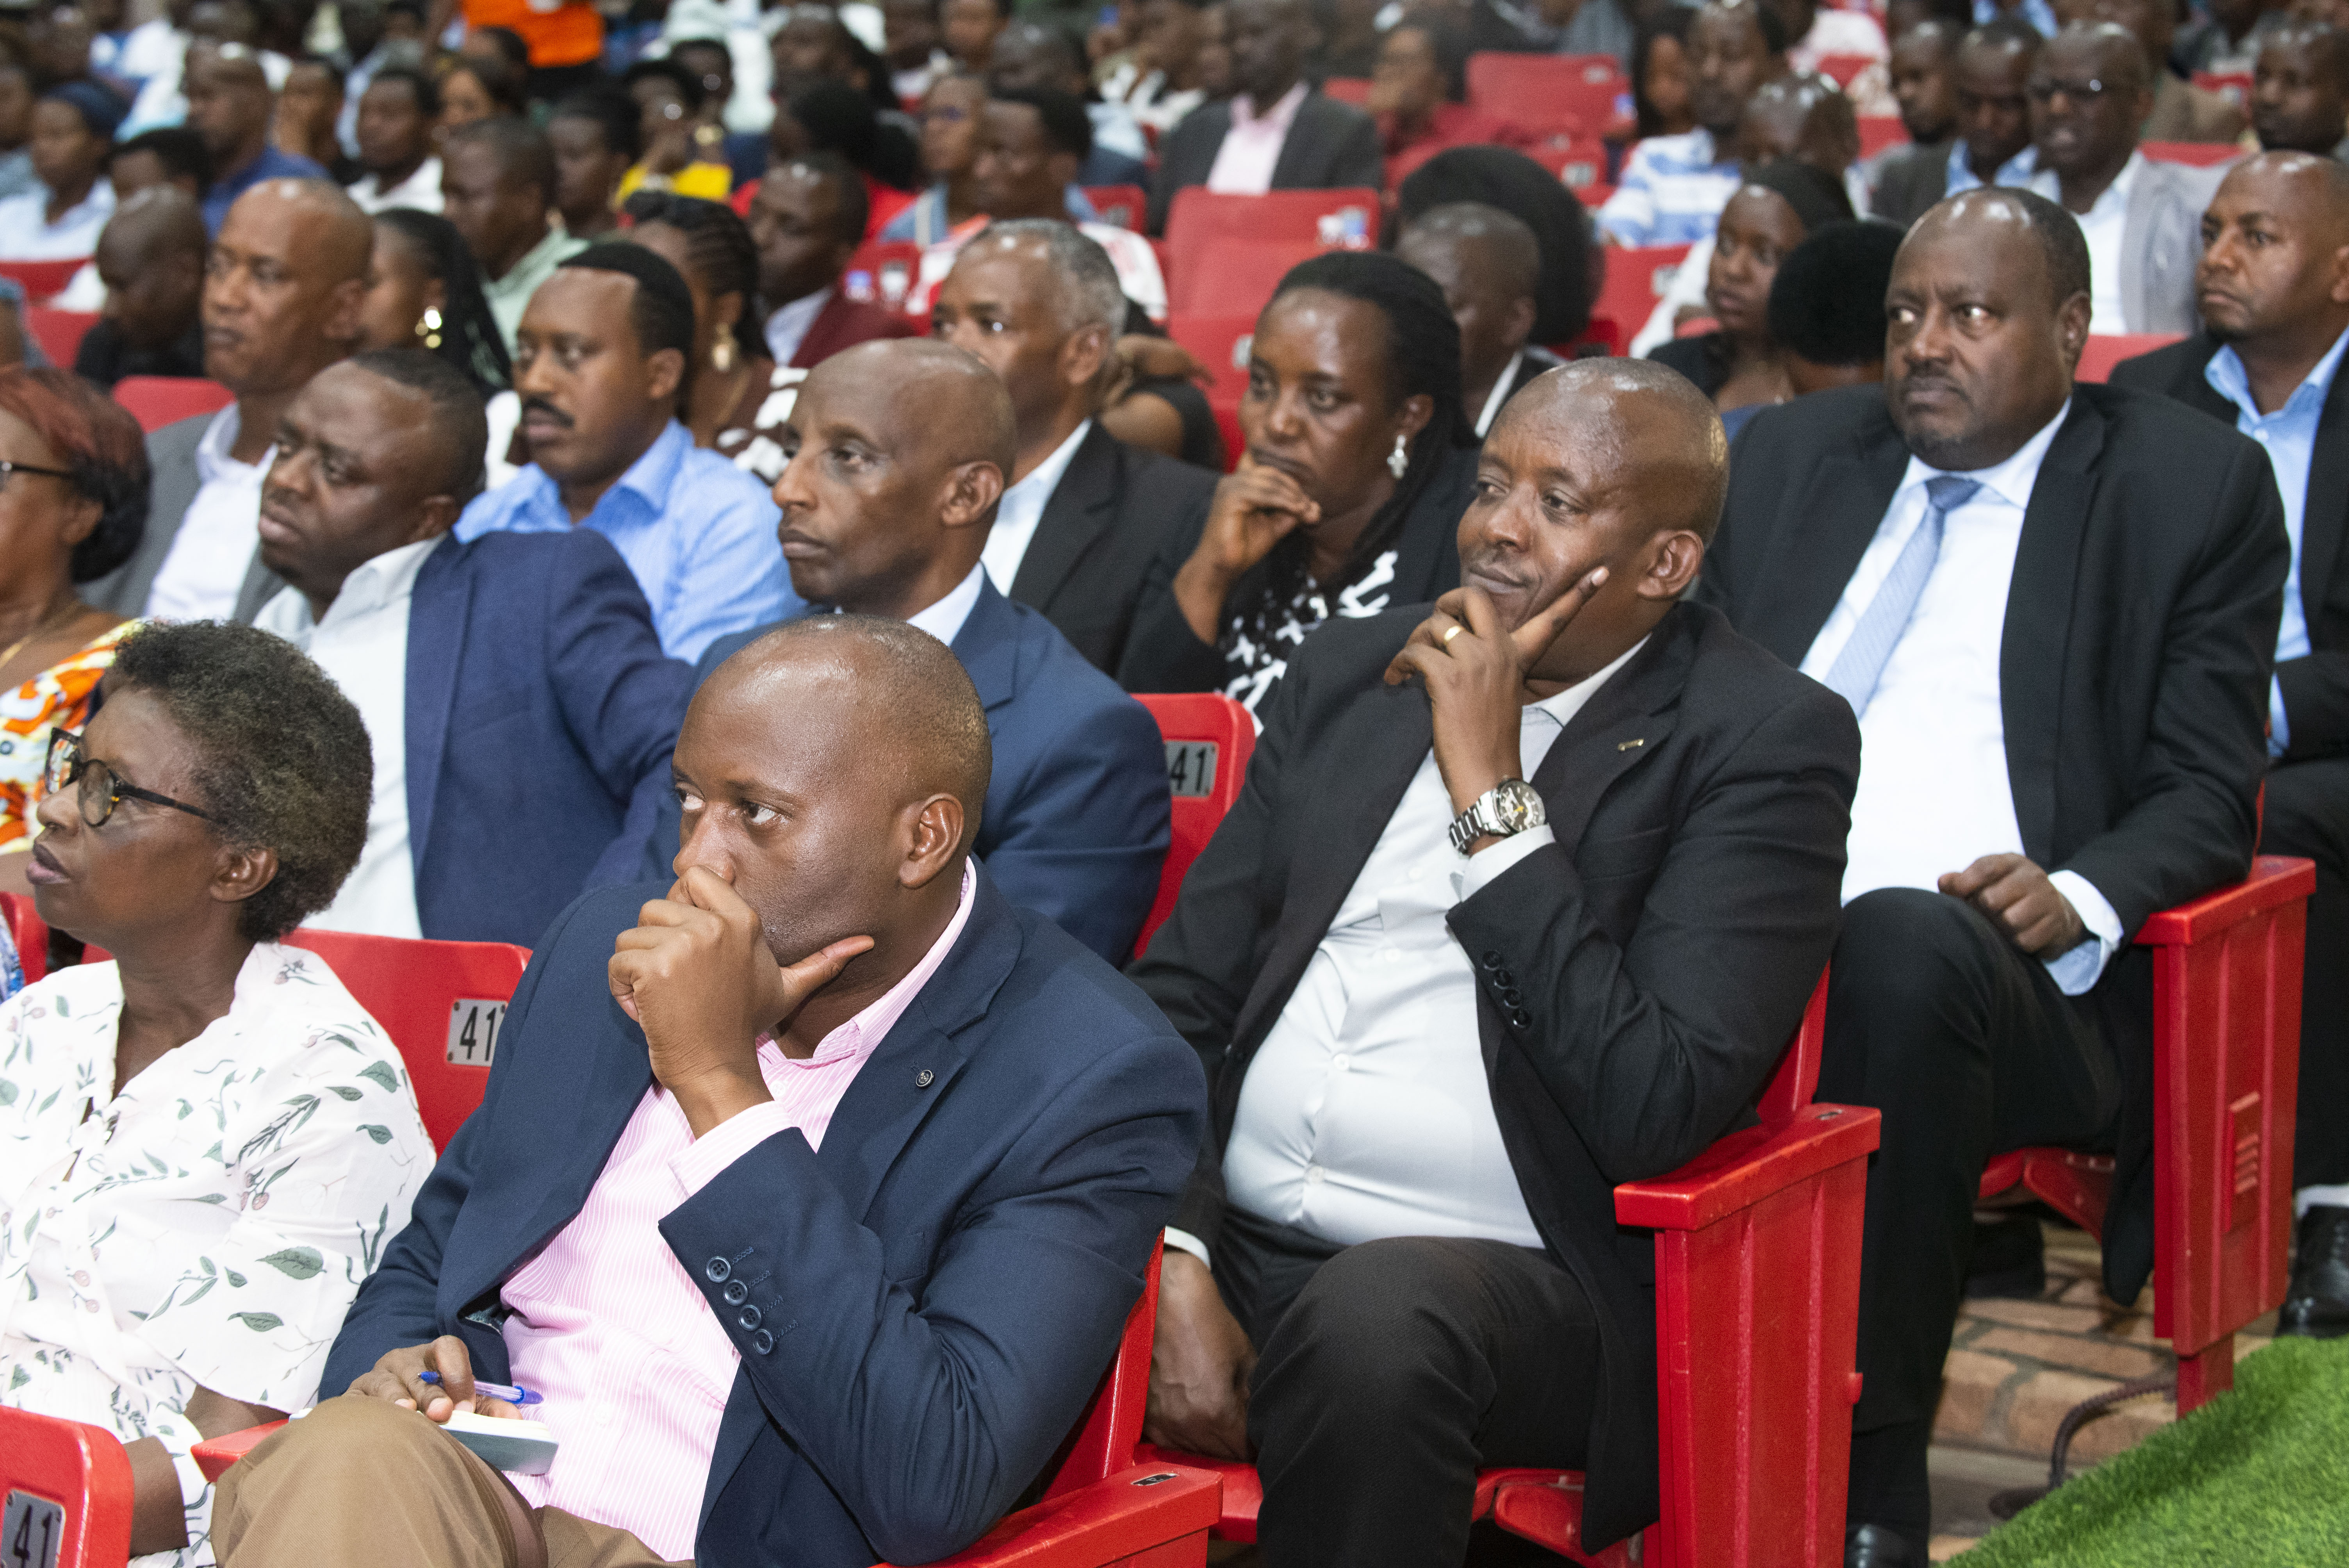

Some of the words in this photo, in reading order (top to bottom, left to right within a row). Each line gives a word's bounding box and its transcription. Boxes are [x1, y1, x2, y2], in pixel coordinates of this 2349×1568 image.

[1171, 746, 1206, 792] 41
[459, 1006, 496, 1061] 41
[13, 1504, 52, 1568] 41
